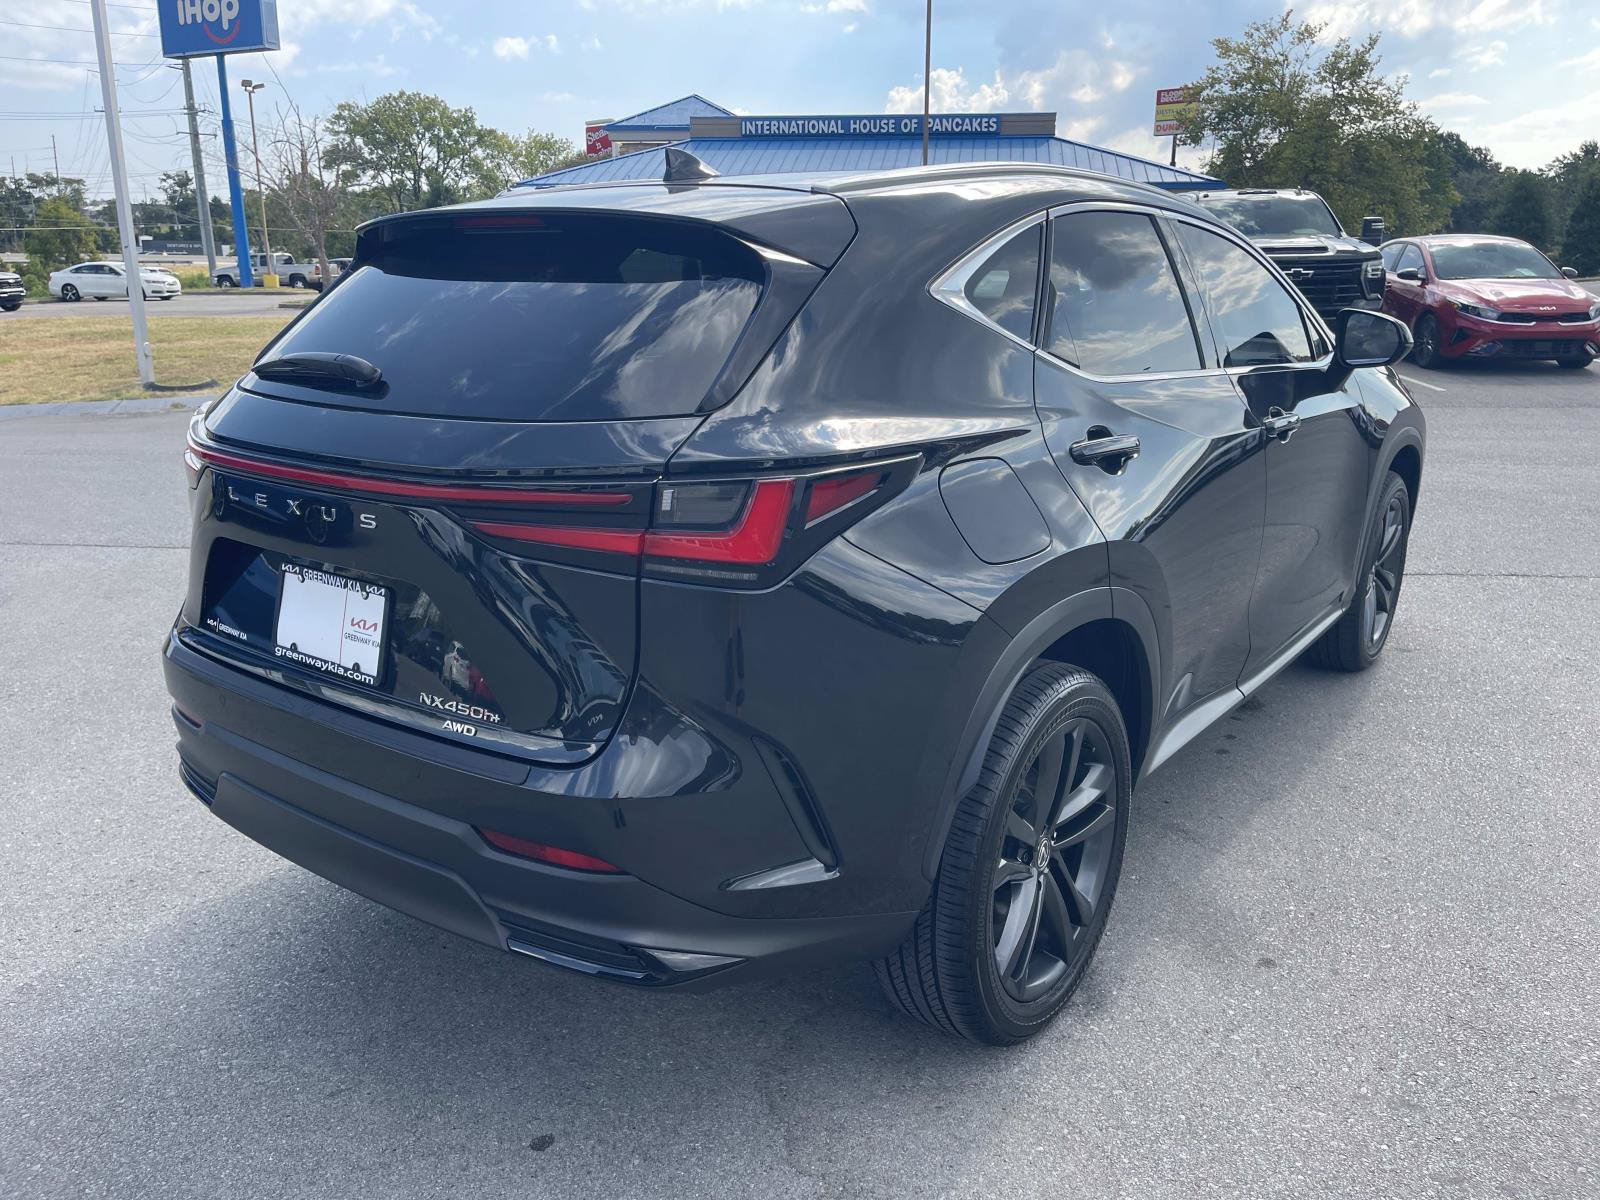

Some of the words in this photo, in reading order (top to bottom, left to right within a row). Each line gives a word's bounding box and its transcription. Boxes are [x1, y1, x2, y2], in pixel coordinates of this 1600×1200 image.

[741, 119, 844, 134] INTERNATIONAL
[850, 119, 895, 133] HOUSE
[901, 118, 918, 132] OF
[927, 117, 997, 131] PANCAKES
[228, 486, 377, 529] LEXUS
[282, 563, 299, 574] KIA
[303, 568, 346, 589] GREENWAY
[347, 579, 361, 593] KIA
[366, 585, 385, 596] KIA
[219, 623, 240, 637] GREENWAY
[351, 617, 378, 632] KIA
[344, 632, 372, 646] GREENWAY
[371, 639, 380, 648] KIA
[275, 646, 374, 685] greenwaykia.com
[420, 692, 500, 723] NX450h+
[442, 720, 476, 737] AWD
